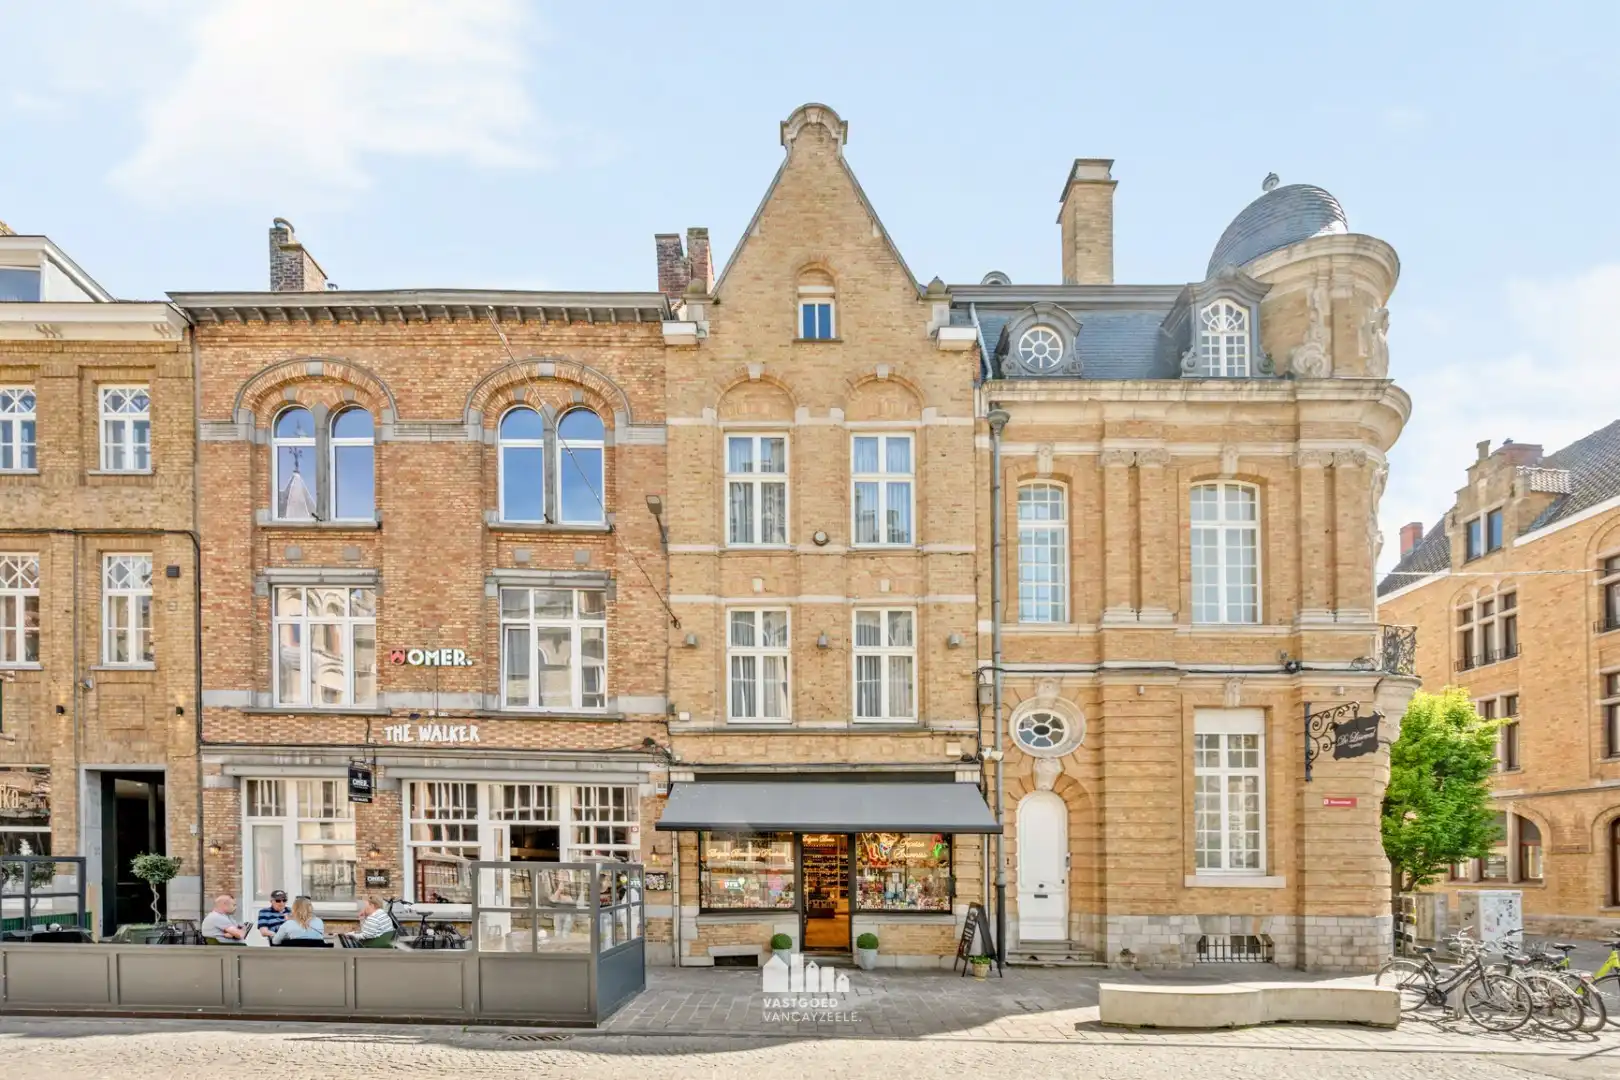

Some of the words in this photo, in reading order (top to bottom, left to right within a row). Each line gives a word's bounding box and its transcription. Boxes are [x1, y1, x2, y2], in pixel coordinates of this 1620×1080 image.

[407, 648, 473, 666] OMER.
[384, 724, 414, 742] THE
[418, 724, 480, 742] WALKER
